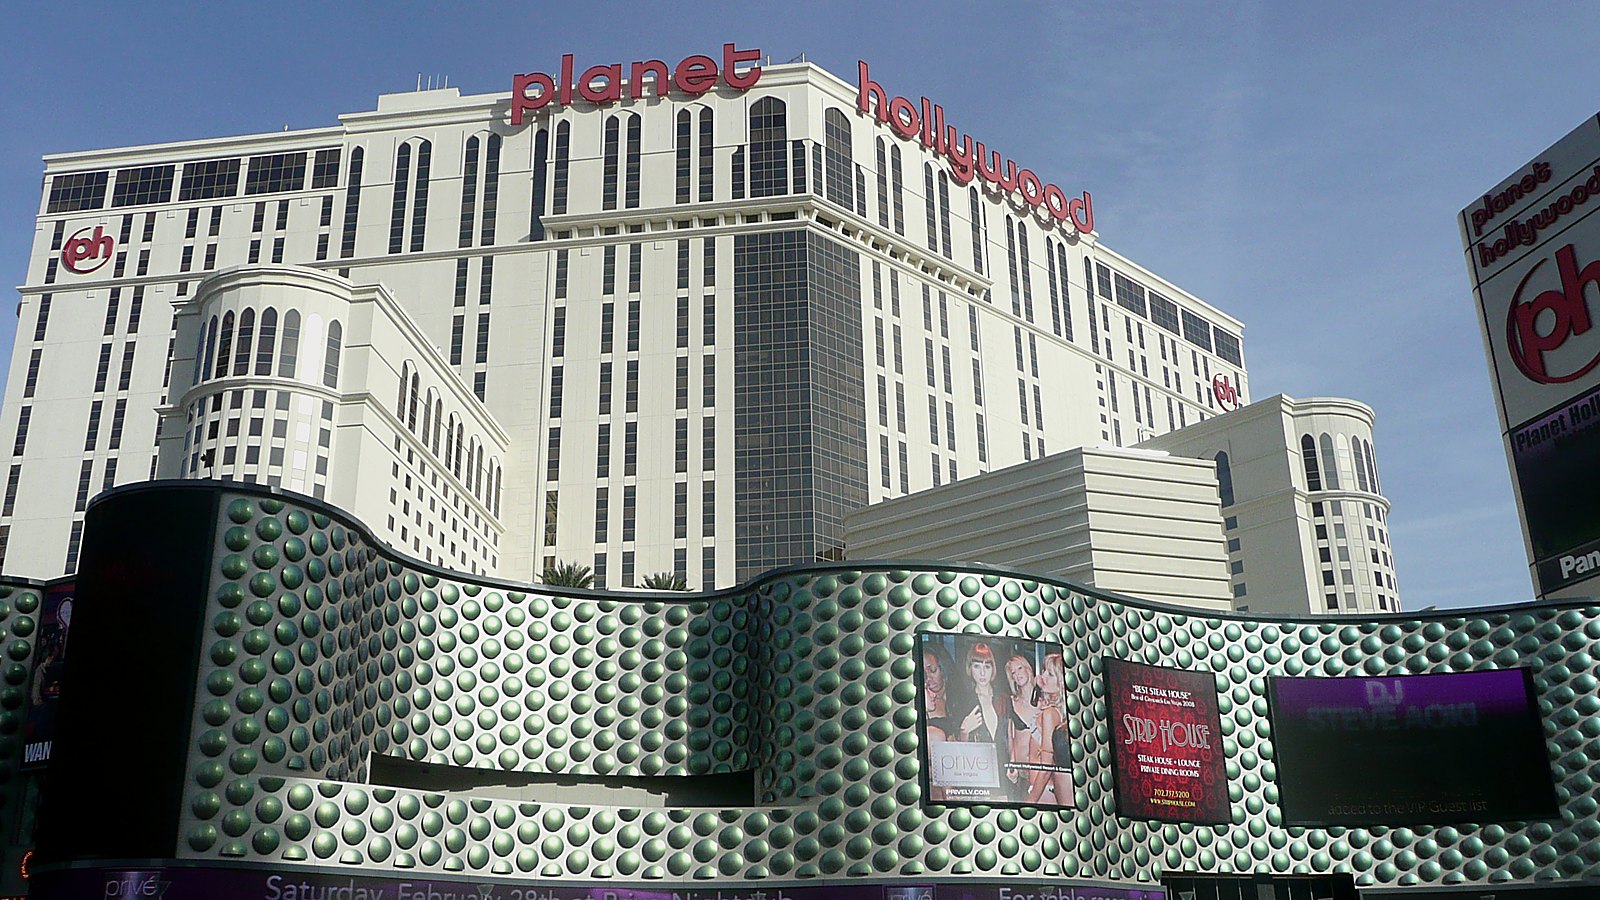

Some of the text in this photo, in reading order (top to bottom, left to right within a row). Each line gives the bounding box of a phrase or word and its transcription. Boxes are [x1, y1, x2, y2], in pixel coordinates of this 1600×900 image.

[511, 42, 1094, 234] planet hollywood
[1471, 162, 1552, 237] planet
[1477, 165, 1600, 268] hollywood
[66, 225, 114, 270] ph
[1515, 243, 1600, 378] ph
[1215, 375, 1238, 407] ph
[1515, 414, 1567, 452] Planet
[1559, 550, 1600, 579] Pan
[1149, 687, 1168, 697] STEAK
[1366, 679, 1403, 706] DJ
[1159, 719, 1211, 753] HOUSE
[1137, 754, 1201, 768] STEAK HOUSE LOUNGE
[1140, 765, 1160, 775] PRIVATE
[1179, 769, 1200, 778] ROOMS
[1383, 800, 1405, 814] the
[1429, 800, 1468, 812] Guest
[1469, 800, 1488, 812] list
[104, 875, 158, 900] privé
